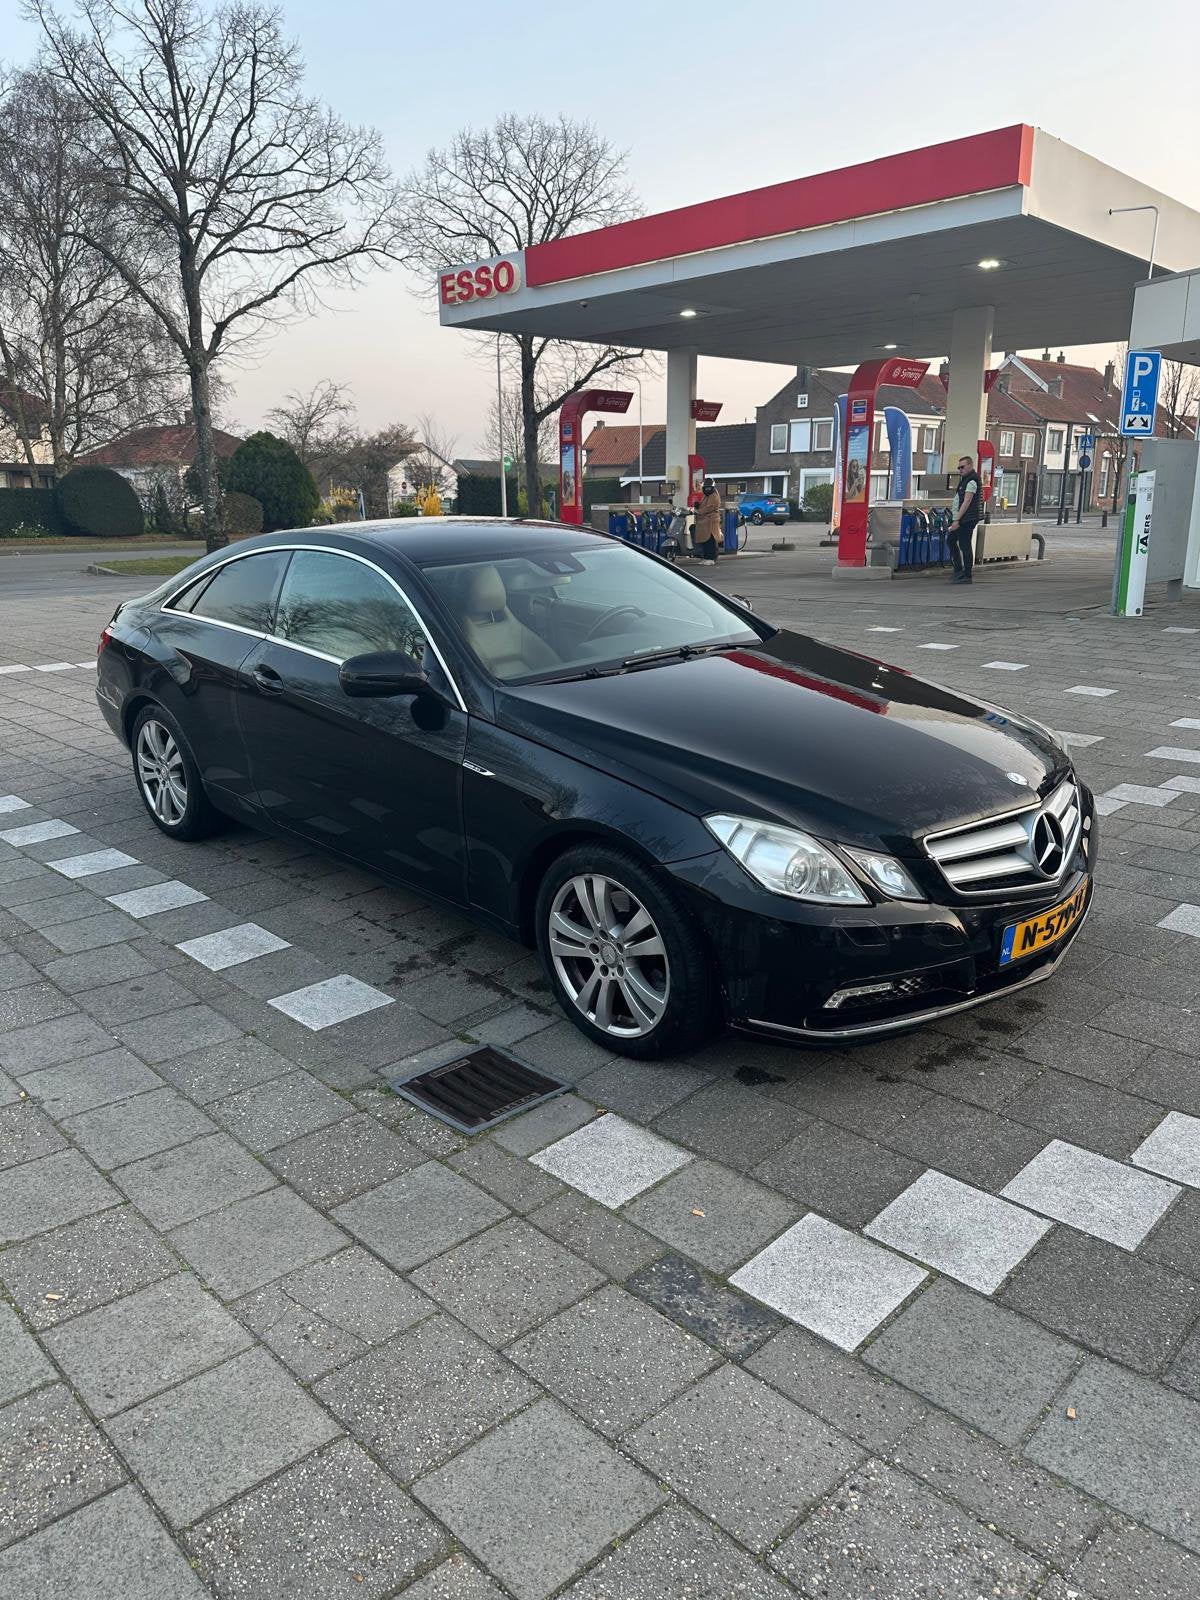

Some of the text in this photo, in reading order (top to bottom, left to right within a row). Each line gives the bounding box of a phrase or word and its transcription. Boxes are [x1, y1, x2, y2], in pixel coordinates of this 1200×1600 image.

[441, 261, 517, 304] ESSO
[901, 369, 922, 381] Synergy
[1133, 357, 1153, 387] P
[606, 398, 627, 409] Synergy
[1002, 947, 1011, 956] NL
